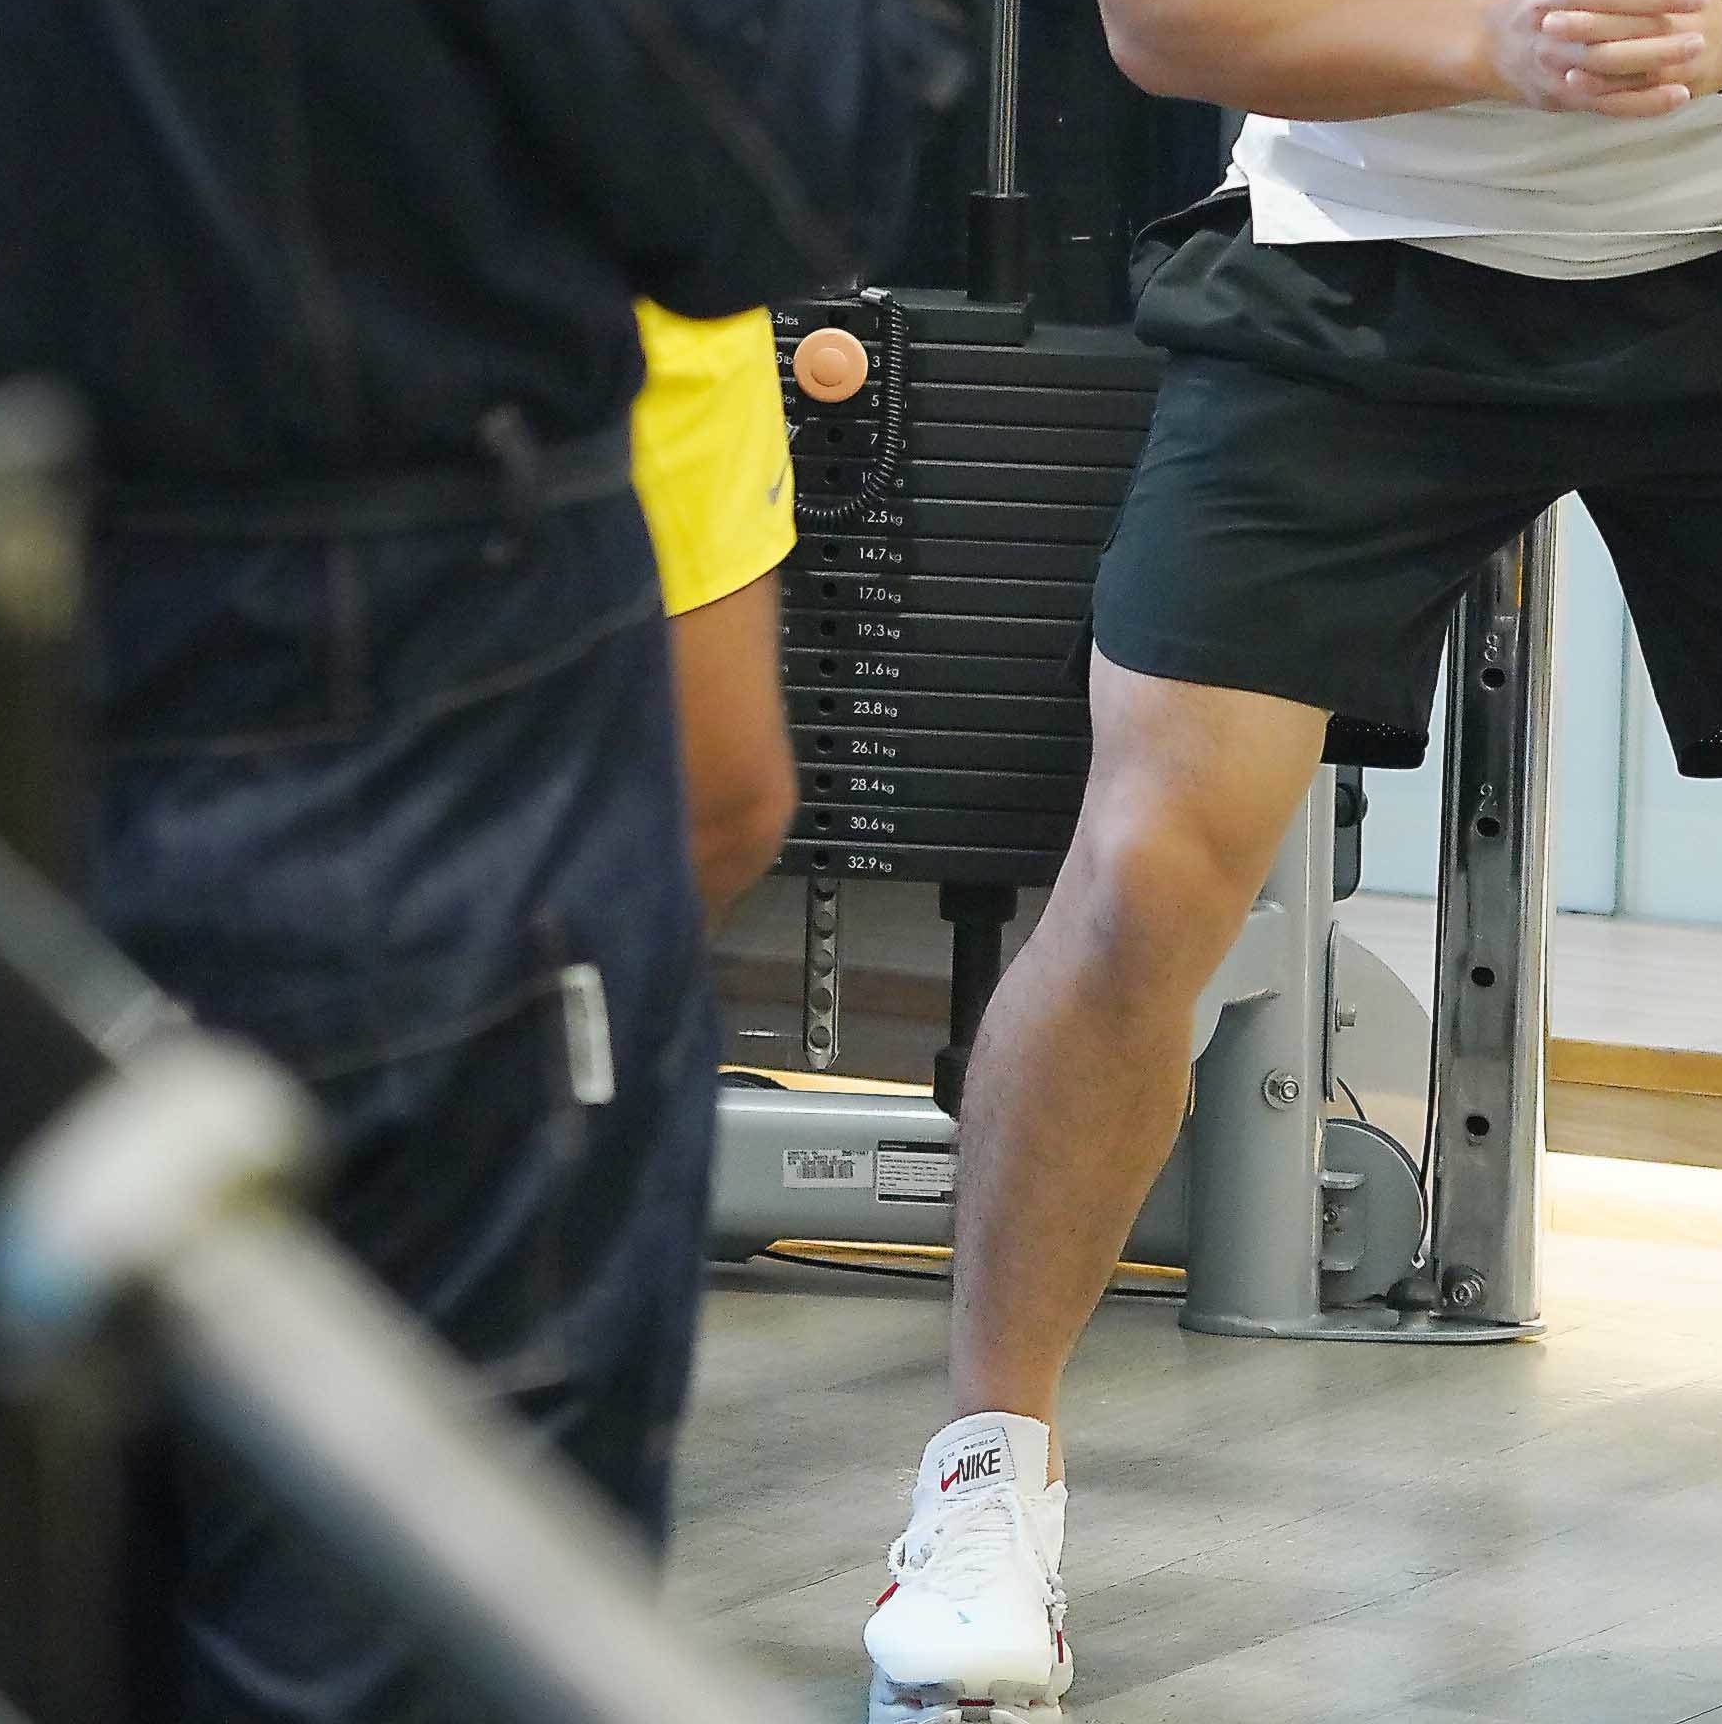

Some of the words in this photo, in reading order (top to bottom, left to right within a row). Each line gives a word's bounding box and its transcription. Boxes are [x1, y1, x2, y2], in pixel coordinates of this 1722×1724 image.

[890, 513, 903, 526] kg
[858, 548, 886, 560] 14.7
[889, 550, 902, 563] kg
[858, 587, 886, 601] 17.0
[888, 591, 901, 604] kg
[857, 624, 885, 637] 19.3
[887, 628, 900, 640] kg
[855, 662, 884, 676] 21.6
[886, 665, 899, 678] kg
[853, 701, 882, 715] 23.8
[884, 706, 898, 718] kg
[852, 741, 879, 754] 26.1
[883, 745, 896, 757] kg
[850, 778, 879, 792] 28.4
[881, 782, 895, 795] kg
[850, 816, 879, 830] 30.6
[881, 820, 895, 834] kg
[847, 855, 877, 869] 32.9
[879, 860, 892, 873] kg
[956, 1447, 1001, 1485] NIKE
